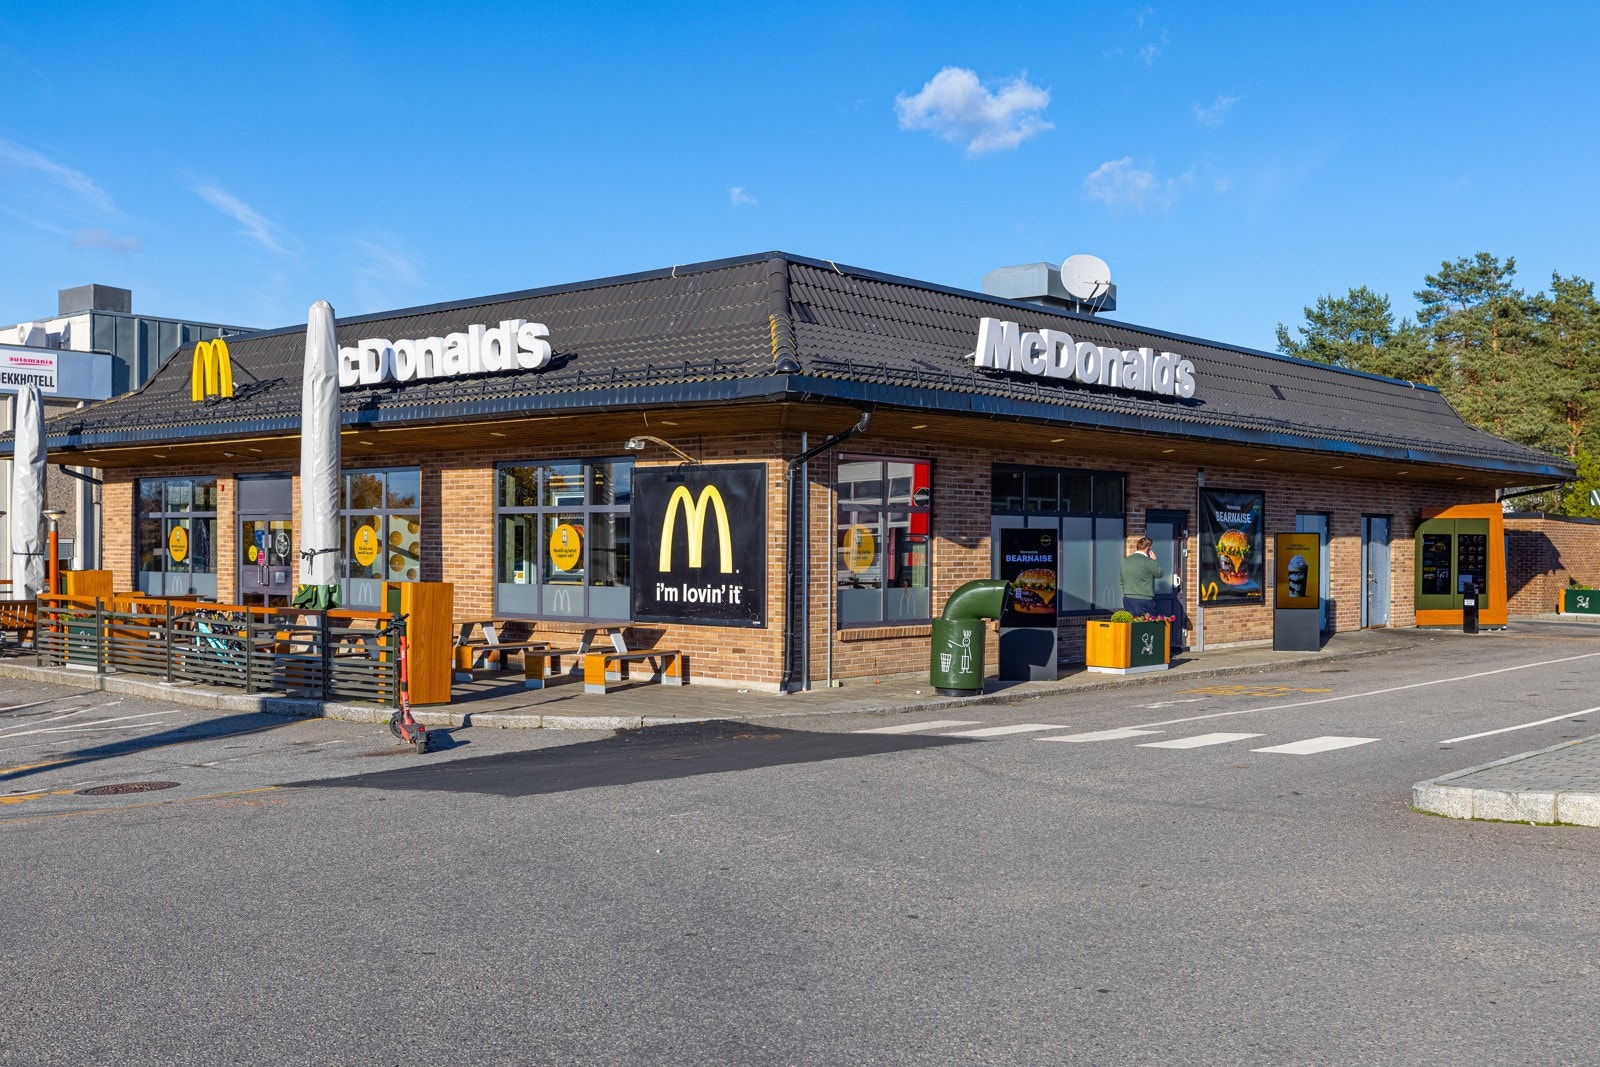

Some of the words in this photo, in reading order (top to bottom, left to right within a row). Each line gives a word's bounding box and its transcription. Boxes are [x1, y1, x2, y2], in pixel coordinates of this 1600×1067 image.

[9, 356, 53, 365] automania
[338, 319, 551, 387] cDonald's
[974, 317, 1196, 398] McDonald's
[0, 372, 55, 388] EKKHOTELL
[1215, 511, 1252, 524] BEARNAISE
[656, 582, 679, 602] i'm
[683, 583, 726, 604] lovin'
